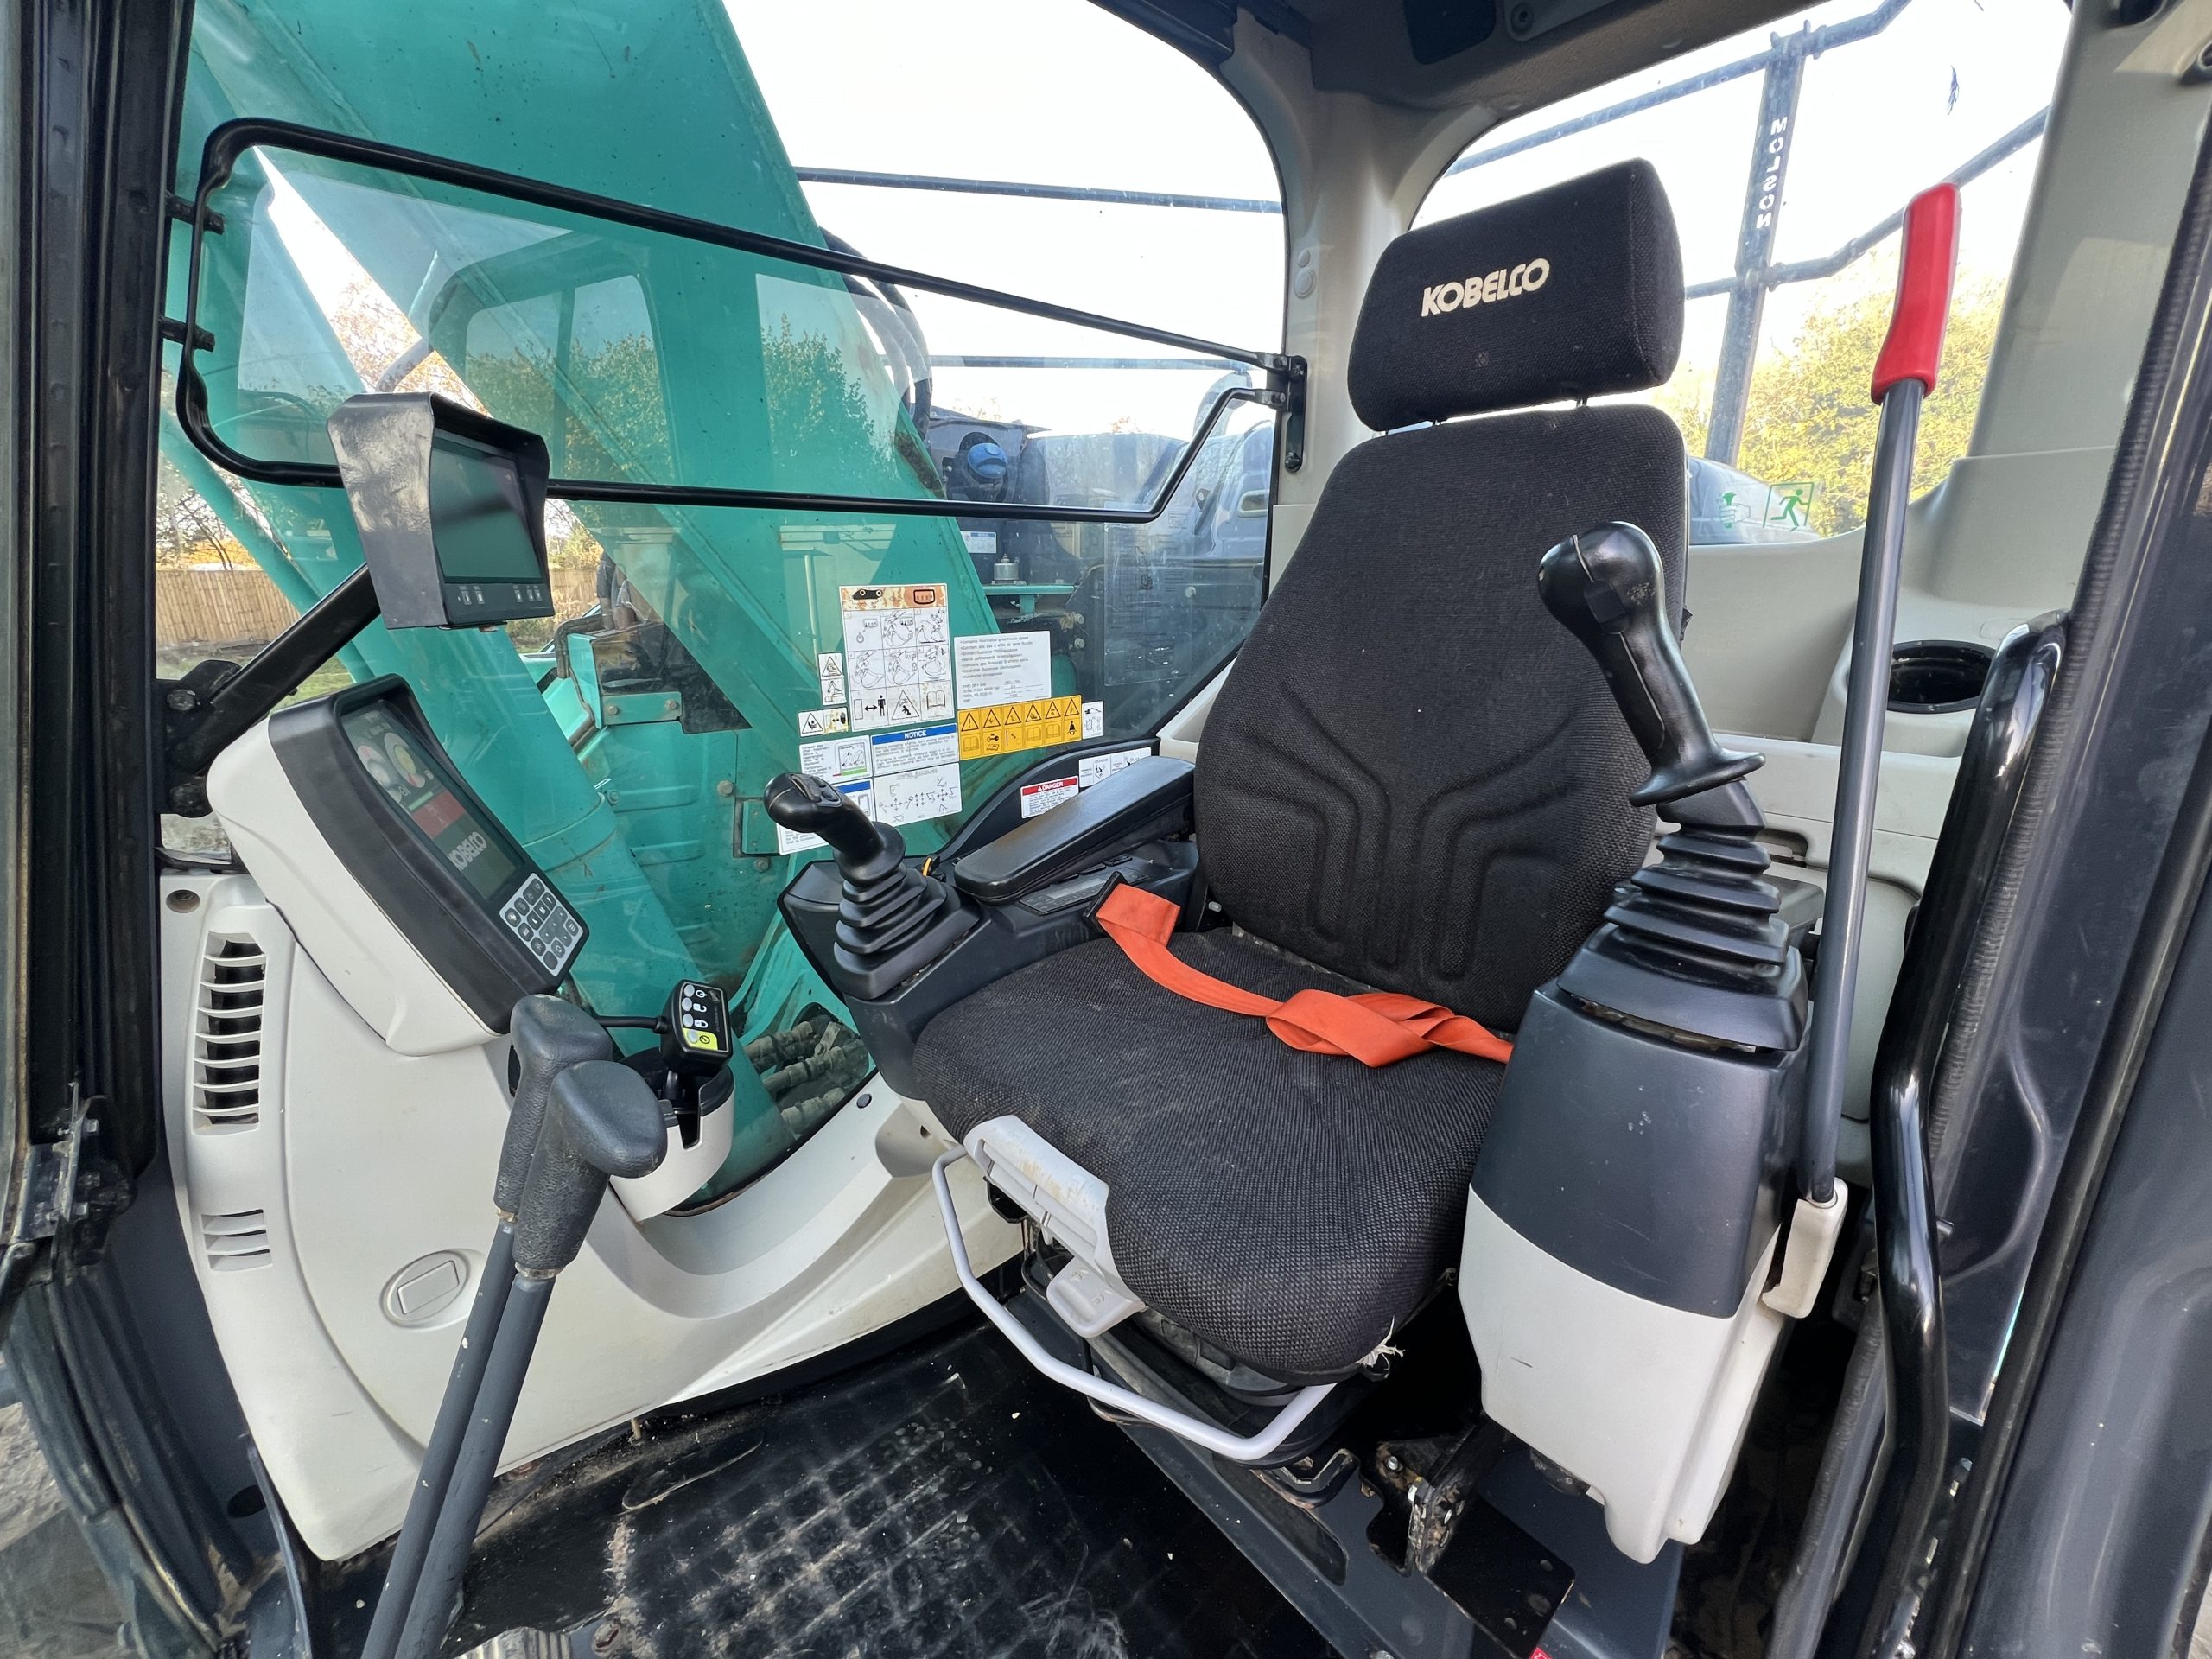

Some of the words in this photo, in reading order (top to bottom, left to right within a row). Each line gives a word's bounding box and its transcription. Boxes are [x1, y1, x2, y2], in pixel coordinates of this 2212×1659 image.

[1421, 258, 1550, 317] KOBELCO
[904, 730, 927, 740] NOTICE
[1041, 781, 1064, 791] DANGER
[447, 831, 487, 871] KOBELCO
